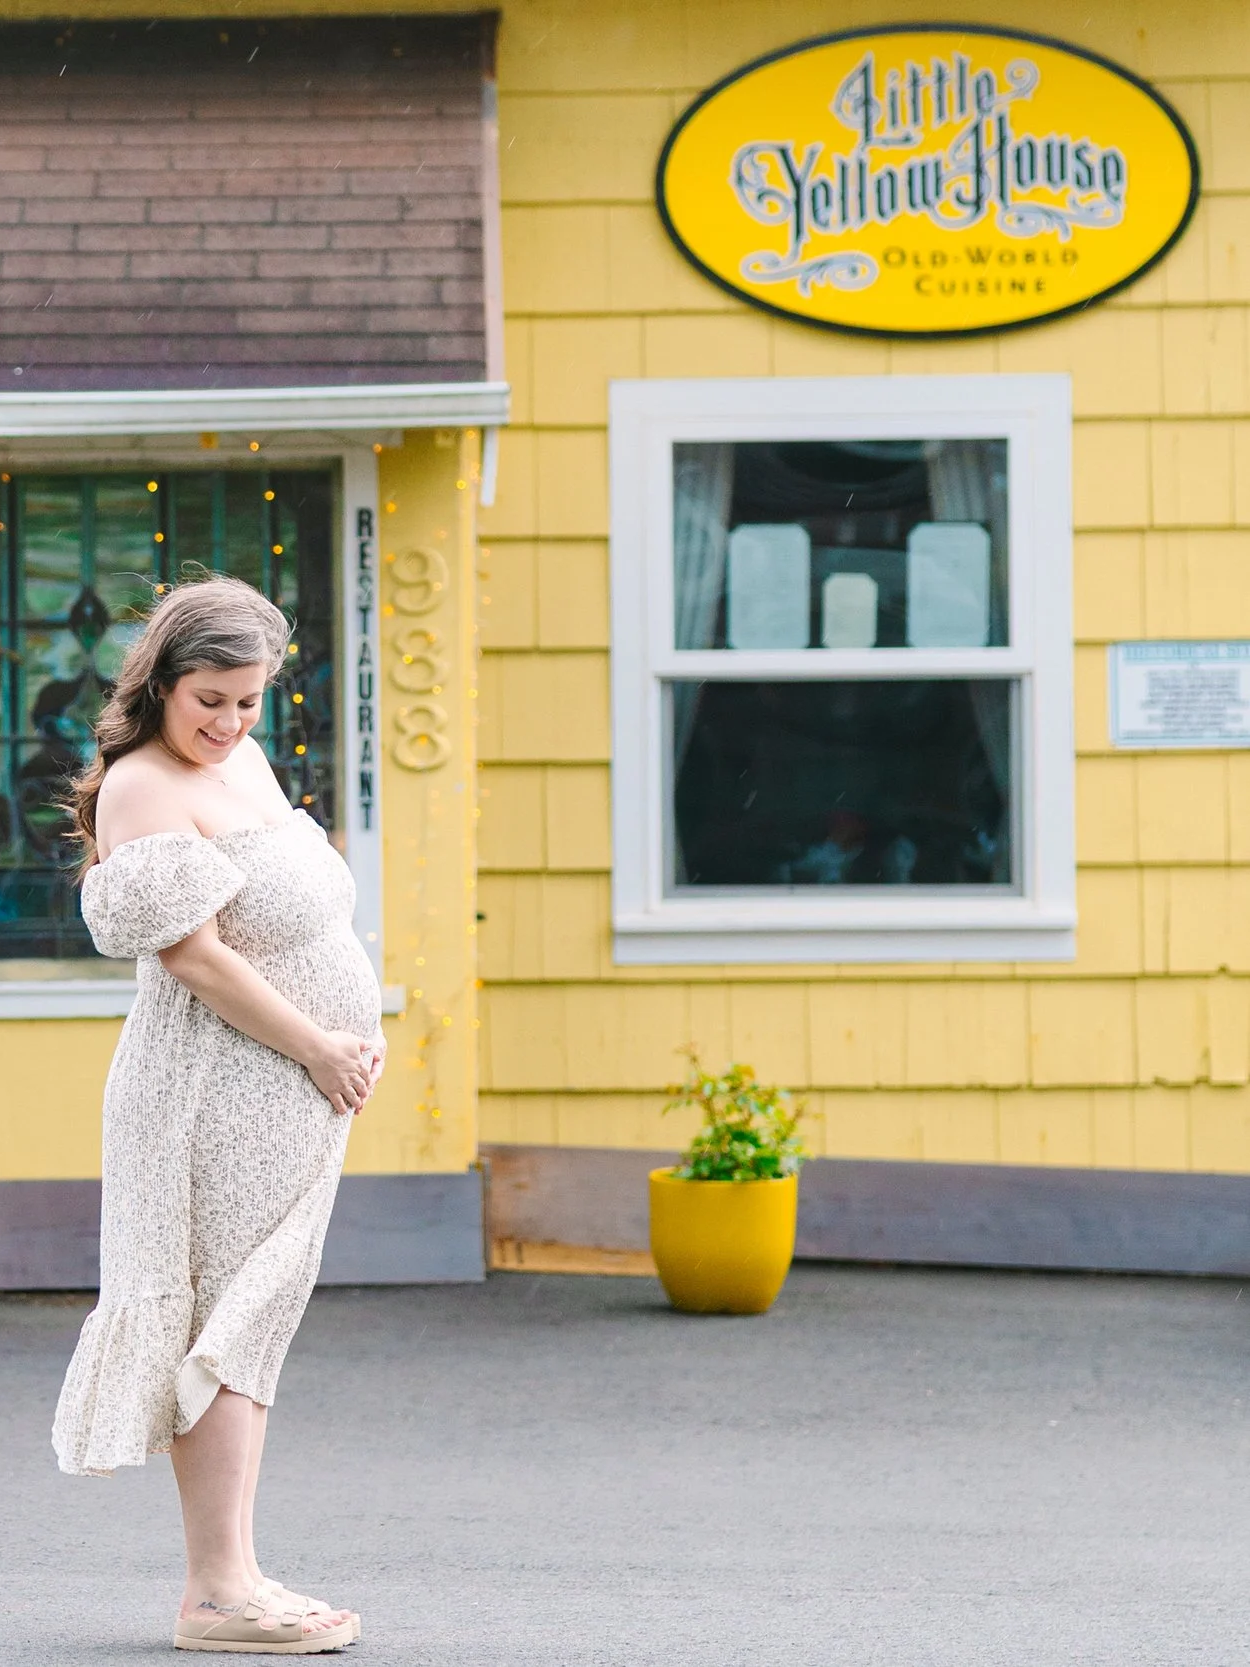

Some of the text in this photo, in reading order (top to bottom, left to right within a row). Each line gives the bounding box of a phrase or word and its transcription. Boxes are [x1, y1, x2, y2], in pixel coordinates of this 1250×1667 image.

[732, 106, 1129, 280] Yellow House
[831, 52, 1038, 147] Little
[356, 508, 374, 831] RESTAURANT
[390, 547, 451, 774] 988
